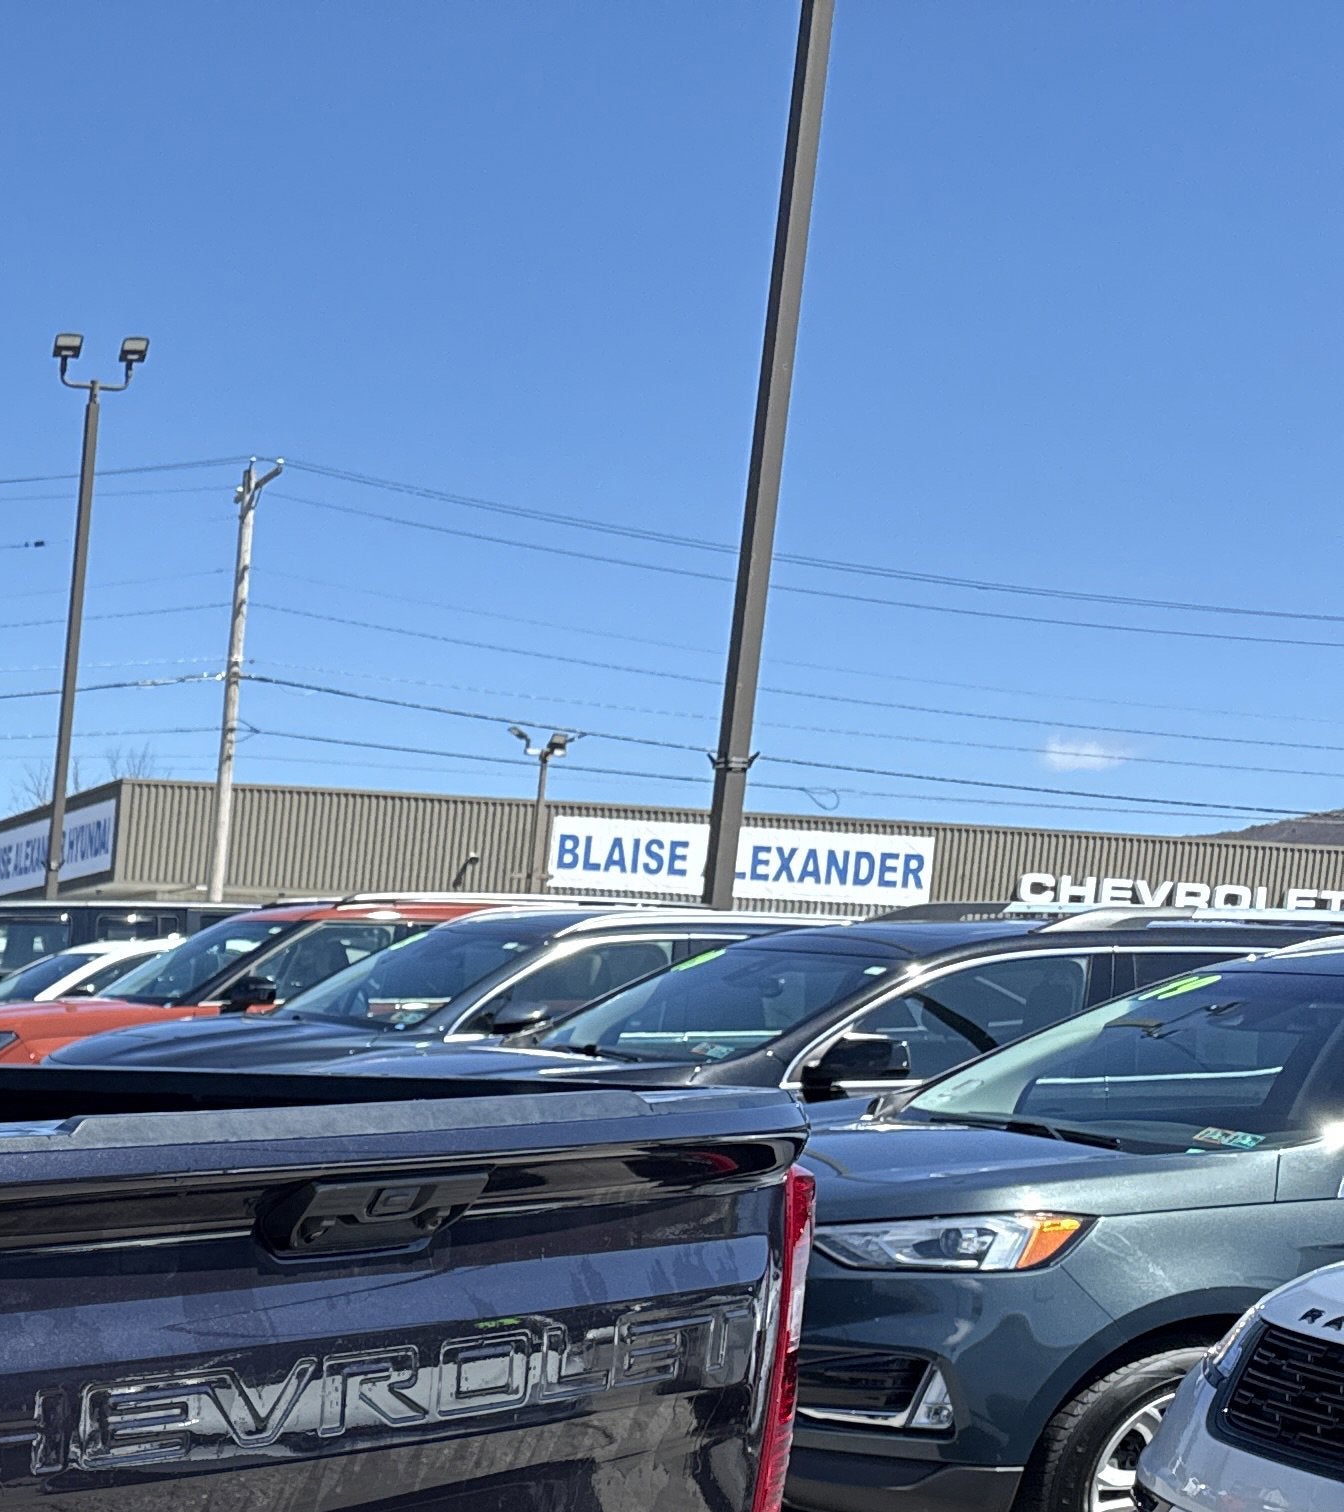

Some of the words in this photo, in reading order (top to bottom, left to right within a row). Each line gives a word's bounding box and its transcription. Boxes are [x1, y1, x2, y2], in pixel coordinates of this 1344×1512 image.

[67, 817, 111, 864] HYUNDAI
[556, 834, 690, 877] BLAISE
[700, 844, 925, 890] EXANDER
